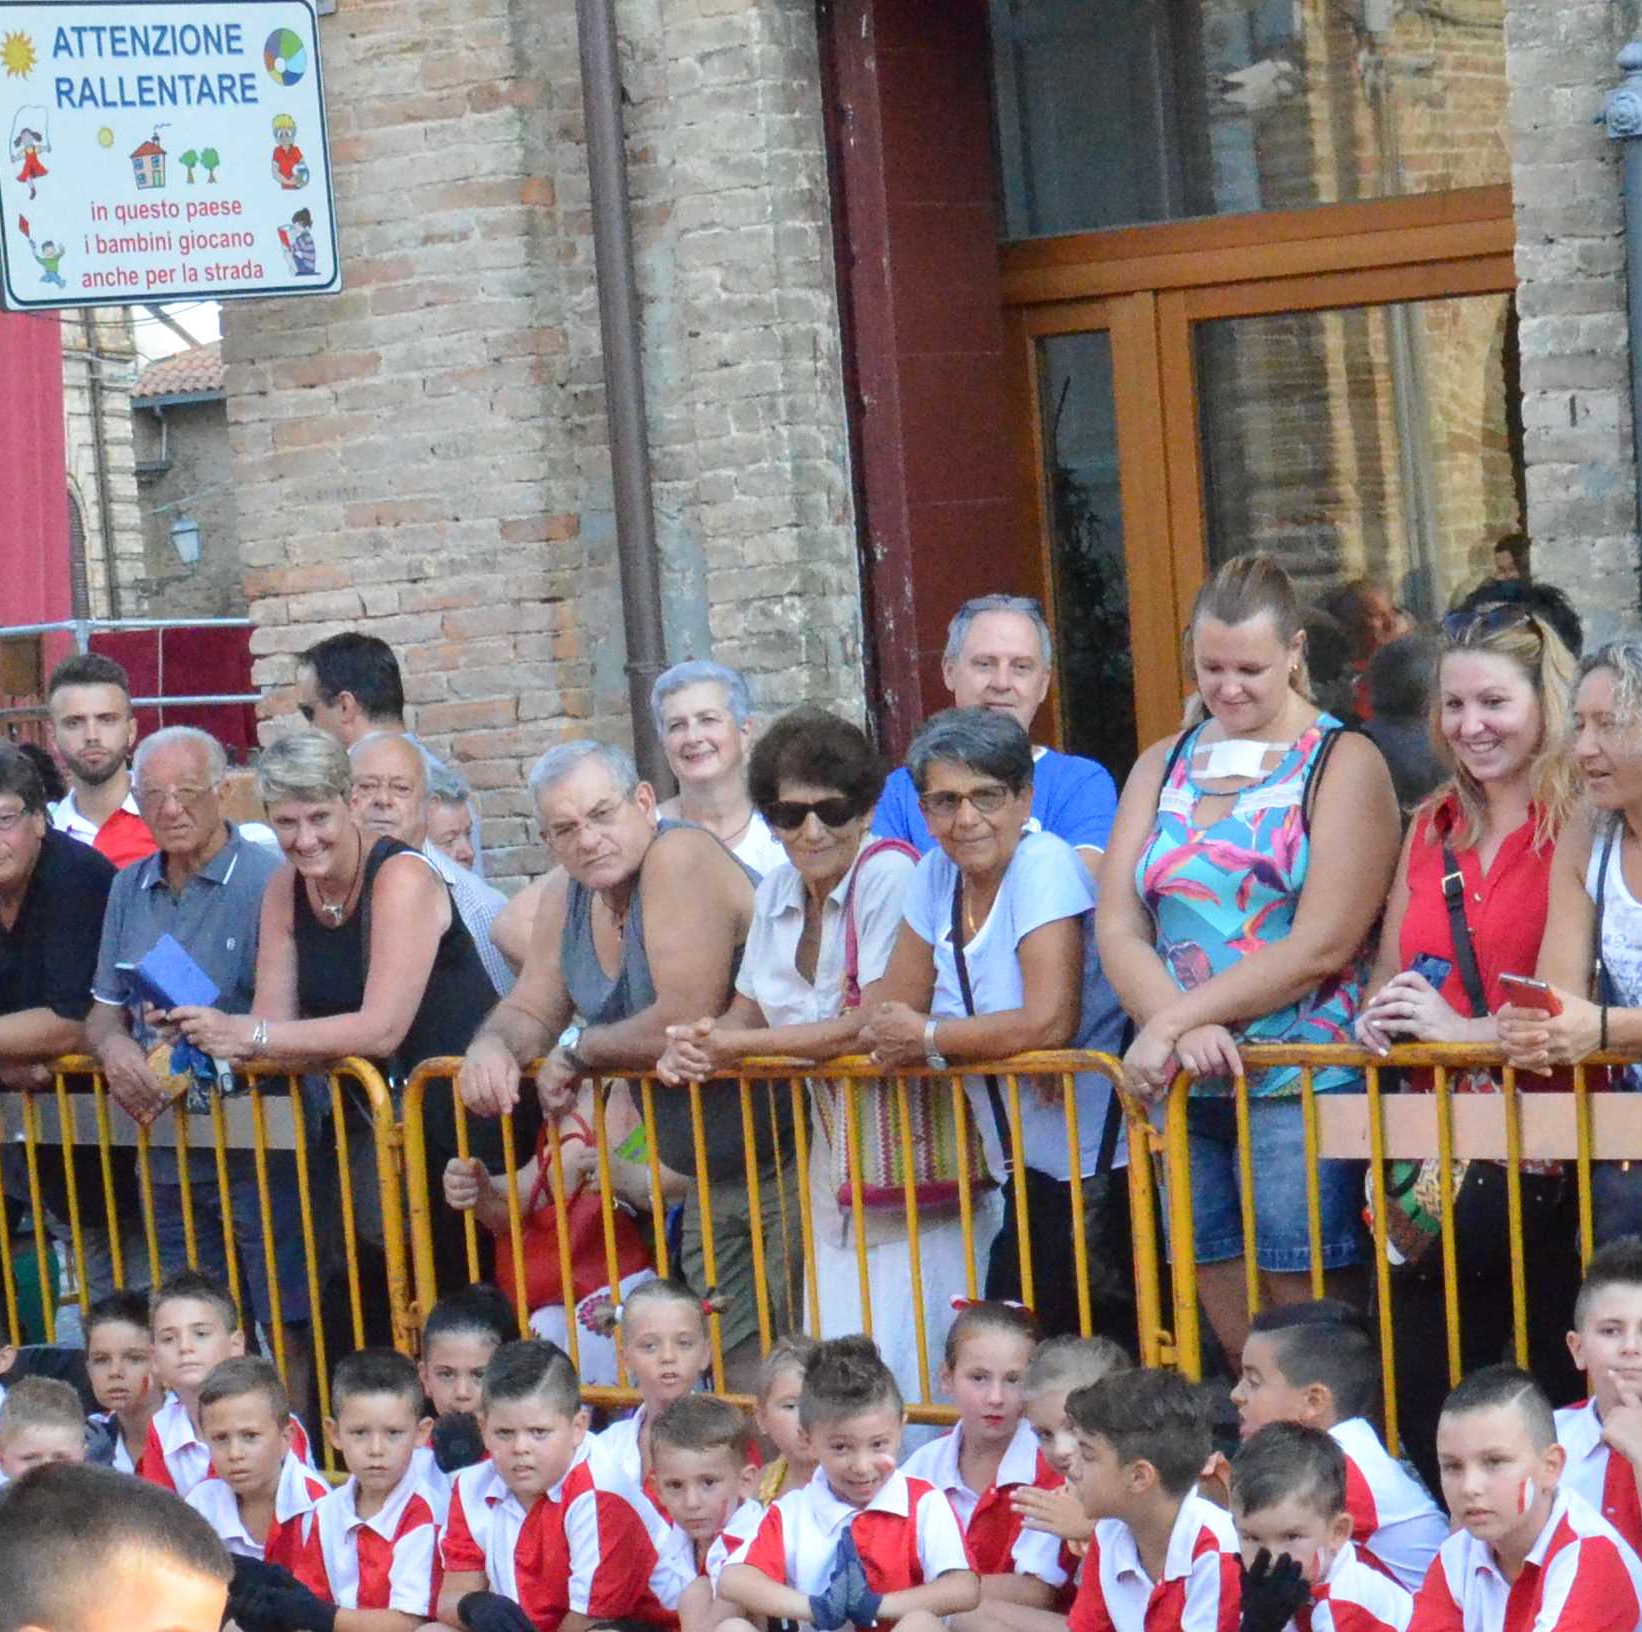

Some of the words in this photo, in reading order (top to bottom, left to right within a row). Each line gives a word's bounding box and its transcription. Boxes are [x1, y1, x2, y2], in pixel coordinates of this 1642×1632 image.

[52, 24, 245, 58] ATTENZIONE
[55, 73, 259, 108] RALLENTARE
[91, 201, 108, 221] in
[115, 200, 180, 226] questo
[186, 200, 242, 223] paese
[85, 236, 90, 254] i
[96, 233, 172, 254] bambini
[179, 230, 254, 257] giocano
[82, 266, 139, 289] anche
[146, 267, 176, 290] per
[182, 263, 198, 283] la
[205, 260, 264, 281] strada
